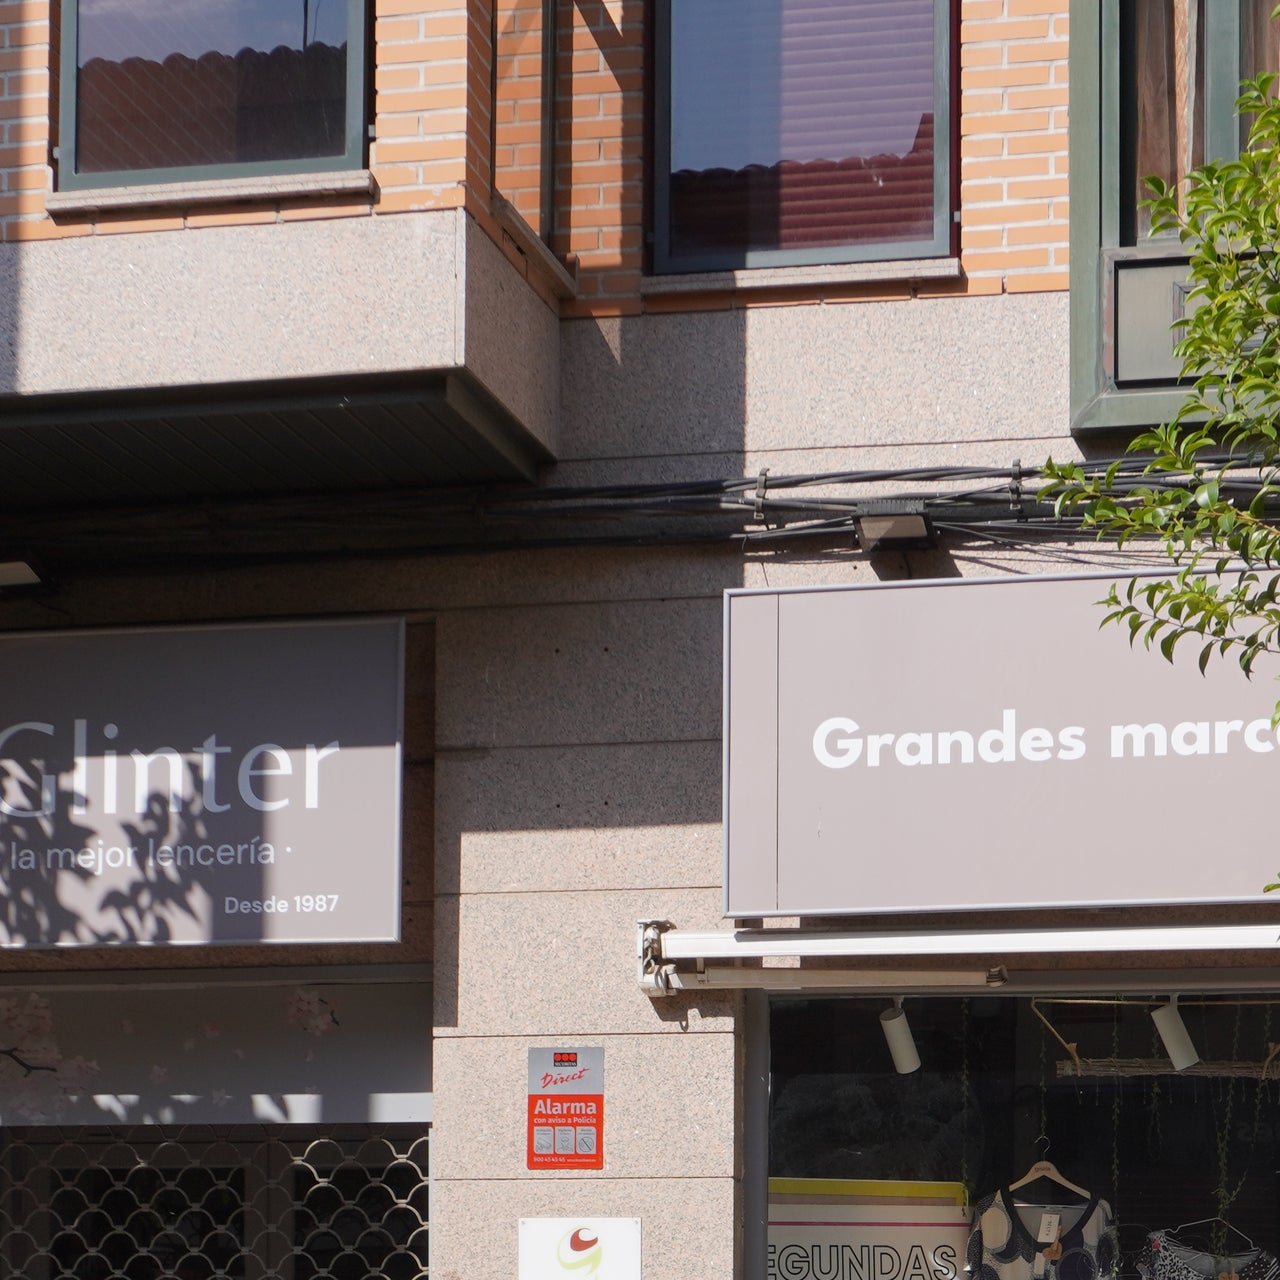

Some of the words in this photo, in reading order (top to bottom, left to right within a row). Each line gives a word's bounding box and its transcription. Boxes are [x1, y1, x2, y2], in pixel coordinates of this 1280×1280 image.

[812, 708, 1087, 770] Grandes
[10, 841, 36, 869] la
[46, 843, 138, 877] mejor
[148, 837, 276, 869] lencería
[224, 895, 289, 915] Desde
[293, 894, 340, 913] 1987
[540, 1068, 591, 1089] Direct
[534, 1098, 597, 1115] Alarma
[547, 1115, 567, 1124] aviso
